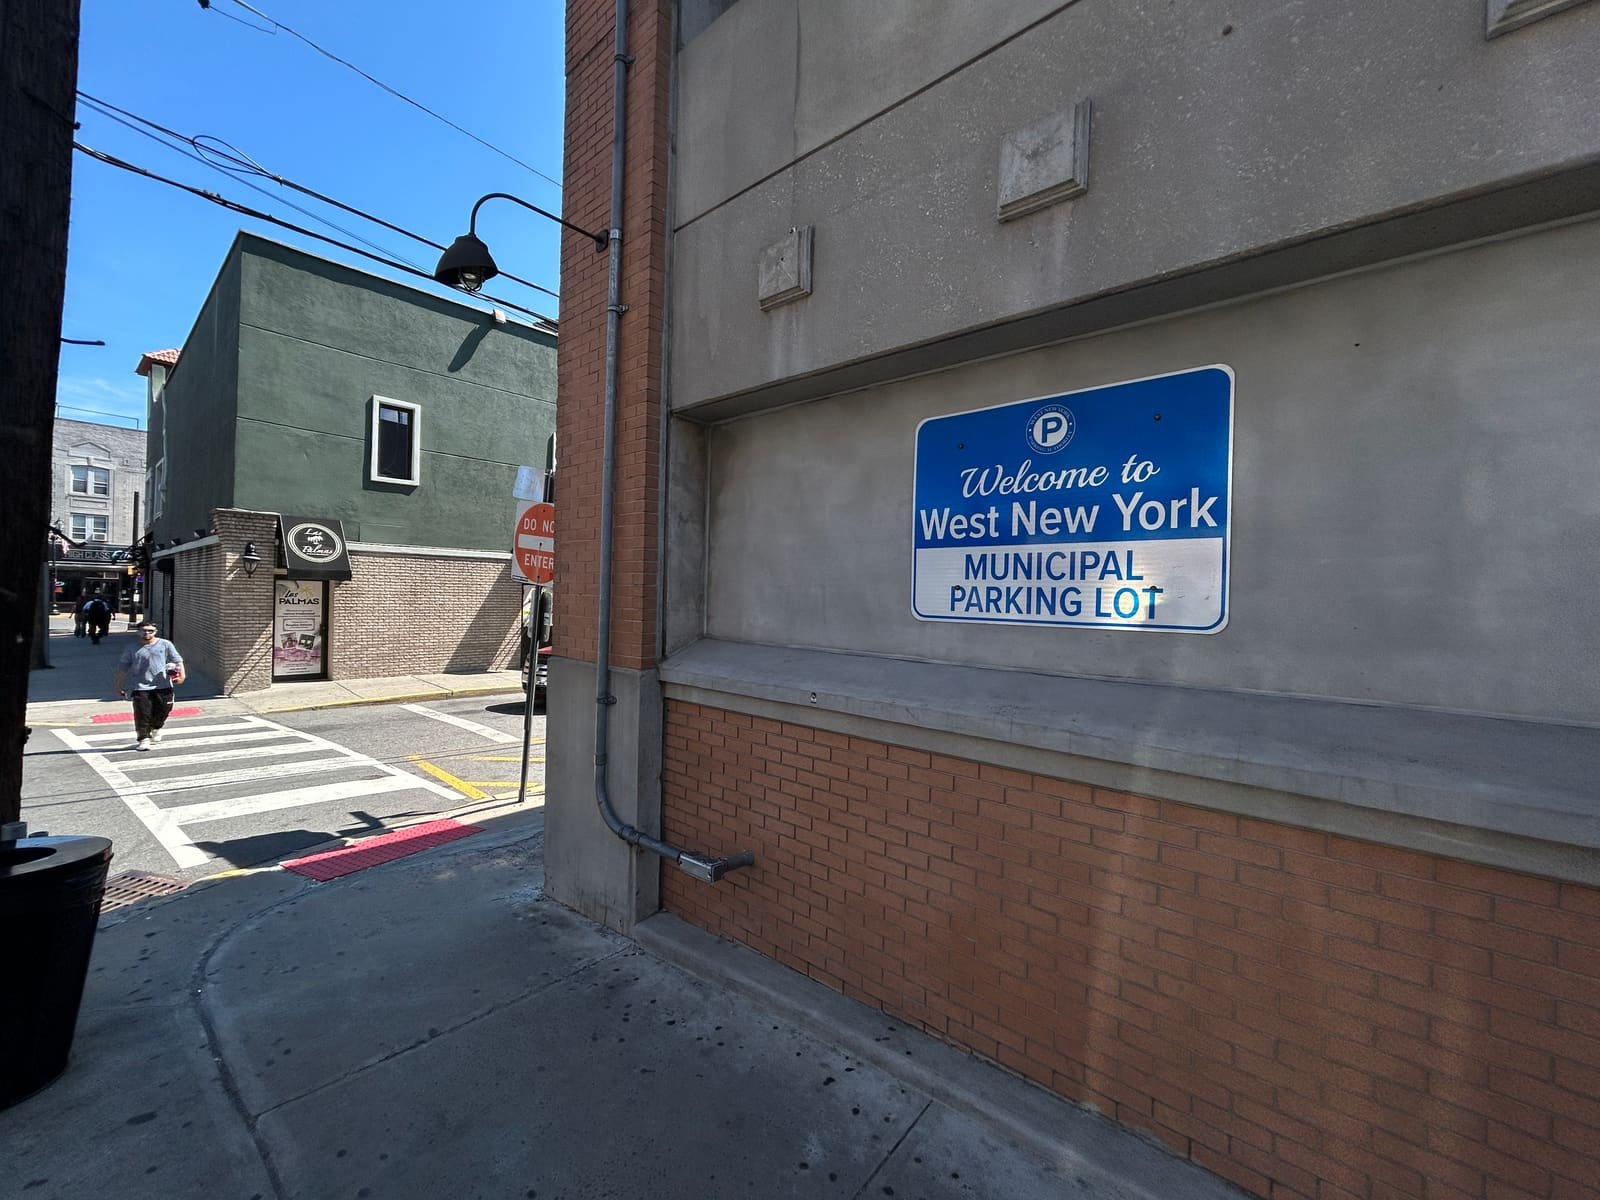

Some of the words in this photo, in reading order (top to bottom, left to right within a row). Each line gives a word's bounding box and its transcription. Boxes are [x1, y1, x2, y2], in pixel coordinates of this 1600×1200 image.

[1041, 416, 1063, 444] P
[960, 459, 1109, 498] Welcome
[1120, 454, 1161, 484] to
[523, 518, 537, 531] DO
[542, 519, 555, 533] NO
[919, 506, 999, 541] West
[1011, 500, 1100, 537] New
[1112, 487, 1219, 532] York
[85, 551, 111, 560] CLASS
[524, 553, 554, 570] ENTER
[963, 550, 1144, 582] MUNICIPAL
[279, 597, 320, 605] PALMAS
[950, 585, 1083, 617] PARKING
[1095, 587, 1164, 620] LOT
